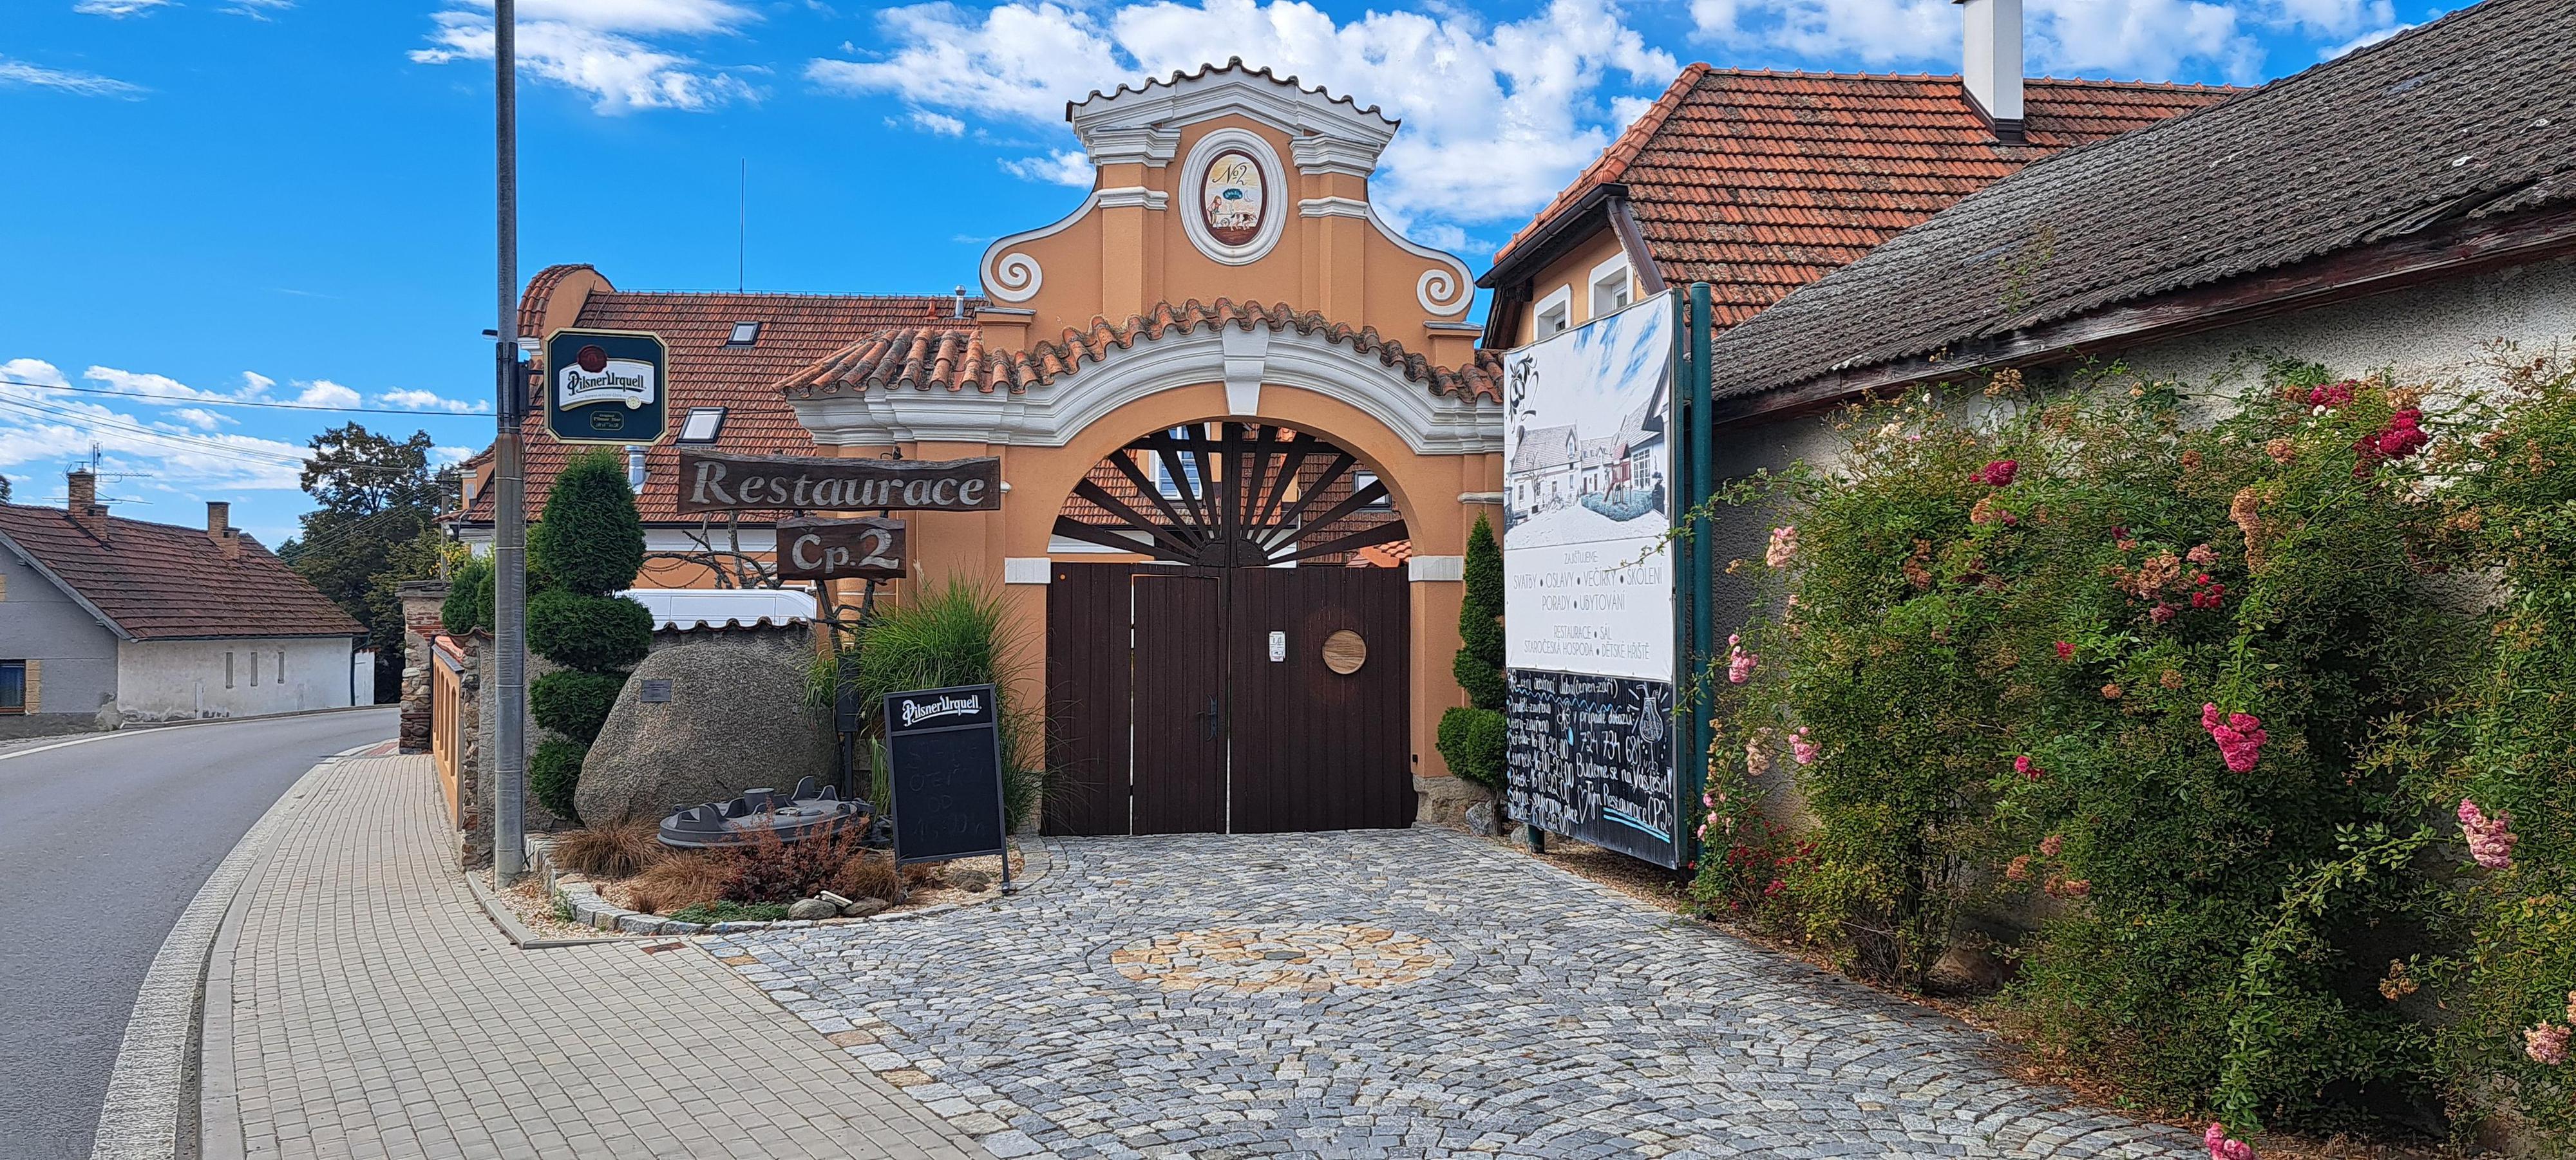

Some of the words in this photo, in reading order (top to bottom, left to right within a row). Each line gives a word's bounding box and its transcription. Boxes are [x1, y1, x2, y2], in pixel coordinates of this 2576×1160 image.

[567, 371, 607, 396] Pilsner
[606, 371, 644, 392] Urquell
[689, 460, 985, 507] Restaurace
[1513, 573, 1538, 589] SVATBY
[1546, 572, 1574, 588] OSLAVY
[1584, 566, 1616, 587] VEČÍRKY
[1627, 563, 1662, 585] ŠKOLENÍ
[1542, 595, 1571, 611] PORADY
[1580, 590, 1626, 611] UBYTOVÁNÍ
[1553, 625, 1591, 639] RESTAURACE
[1600, 623, 1612, 640] SÁL
[1524, 639, 1561, 655] STAROČESKÁ
[1563, 642, 1594, 657] HOSPODA
[1602, 641, 1625, 659] DĚTSKÉ
[1627, 642, 1649, 659] HŘIŠTĚ
[902, 699, 942, 727] Pilsner
[940, 695, 980, 716] Urquell
[1577, 753, 1609, 778] Budeme
[1609, 765, 1618, 780] se
[1621, 769, 1633, 784] na
[1586, 780, 1602, 820] Tým
[1603, 783, 1648, 823] Restaurace
